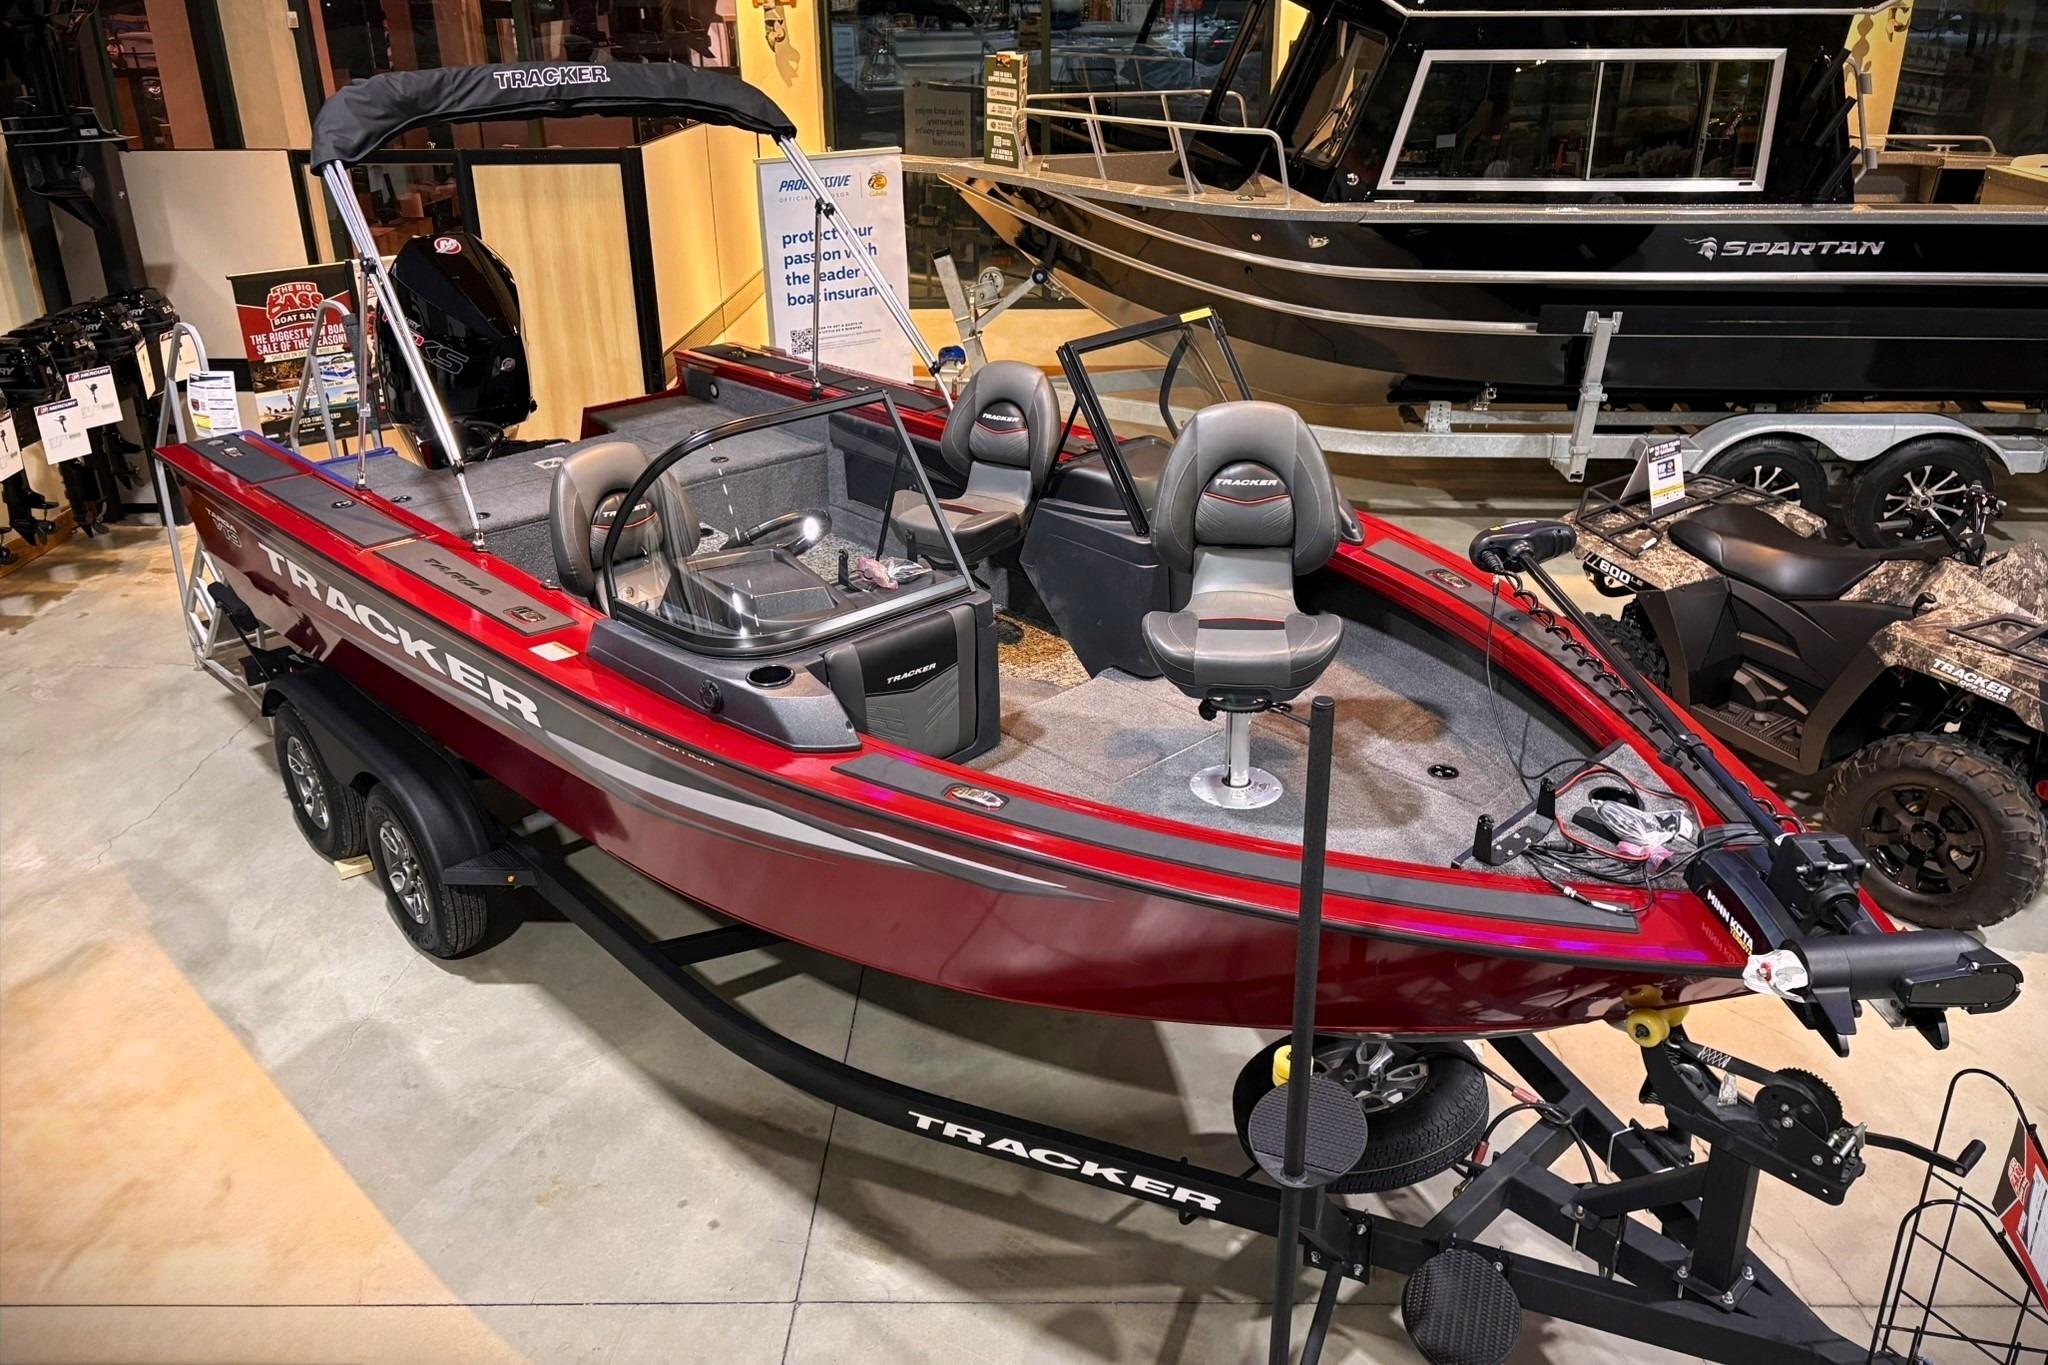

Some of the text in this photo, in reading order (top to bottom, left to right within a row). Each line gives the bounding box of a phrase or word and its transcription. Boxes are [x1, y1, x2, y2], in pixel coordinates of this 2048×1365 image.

[1720, 241, 1886, 256] SPARTAN
[785, 266, 861, 286] the eader
[296, 283, 313, 292] BIG
[121, 320, 134, 330] 3.5
[274, 311, 318, 326] BOAT SAL
[73, 338, 88, 350] 3.5
[250, 334, 269, 346] THE
[269, 329, 306, 343] BIGGEST
[328, 323, 345, 335] BOA
[257, 333, 348, 356] SALE OF THE EASON!
[982, 413, 1020, 423] TRACKER
[1215, 478, 1278, 486] TRACKER
[424, 558, 493, 596] TARGA
[1599, 559, 1631, 585] 600
[258, 541, 542, 729] TRACKER
[887, 662, 937, 684] TRACKER
[1932, 658, 2012, 697] TRACKER
[1707, 888, 1753, 951] MINN KOTA
[907, 1110, 1222, 1212] TRACKER
